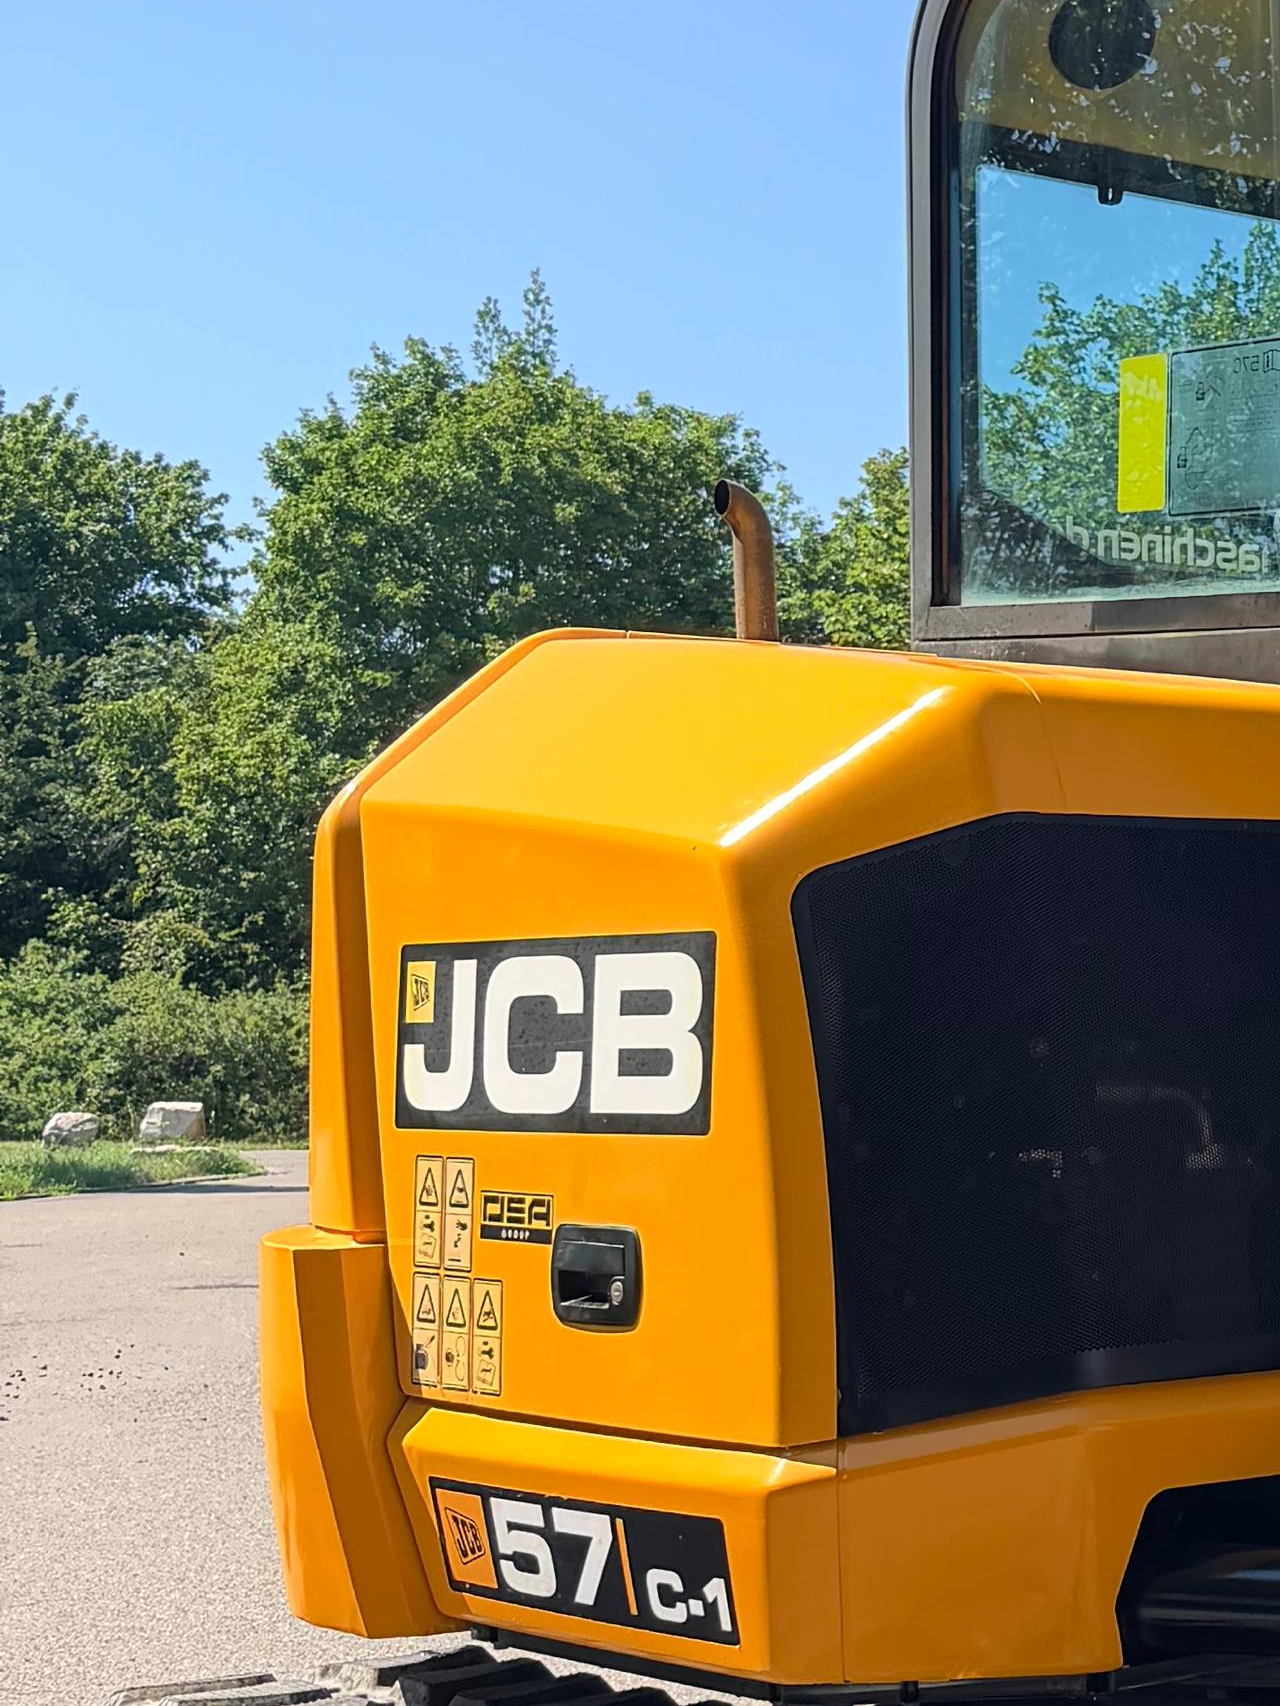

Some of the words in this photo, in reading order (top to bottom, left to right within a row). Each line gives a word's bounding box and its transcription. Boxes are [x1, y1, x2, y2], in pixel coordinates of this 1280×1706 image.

[403, 951, 704, 1115] JCB
[451, 1512, 483, 1558] JCB
[489, 1496, 613, 1606] 57
[646, 1567, 733, 1633] C-1
